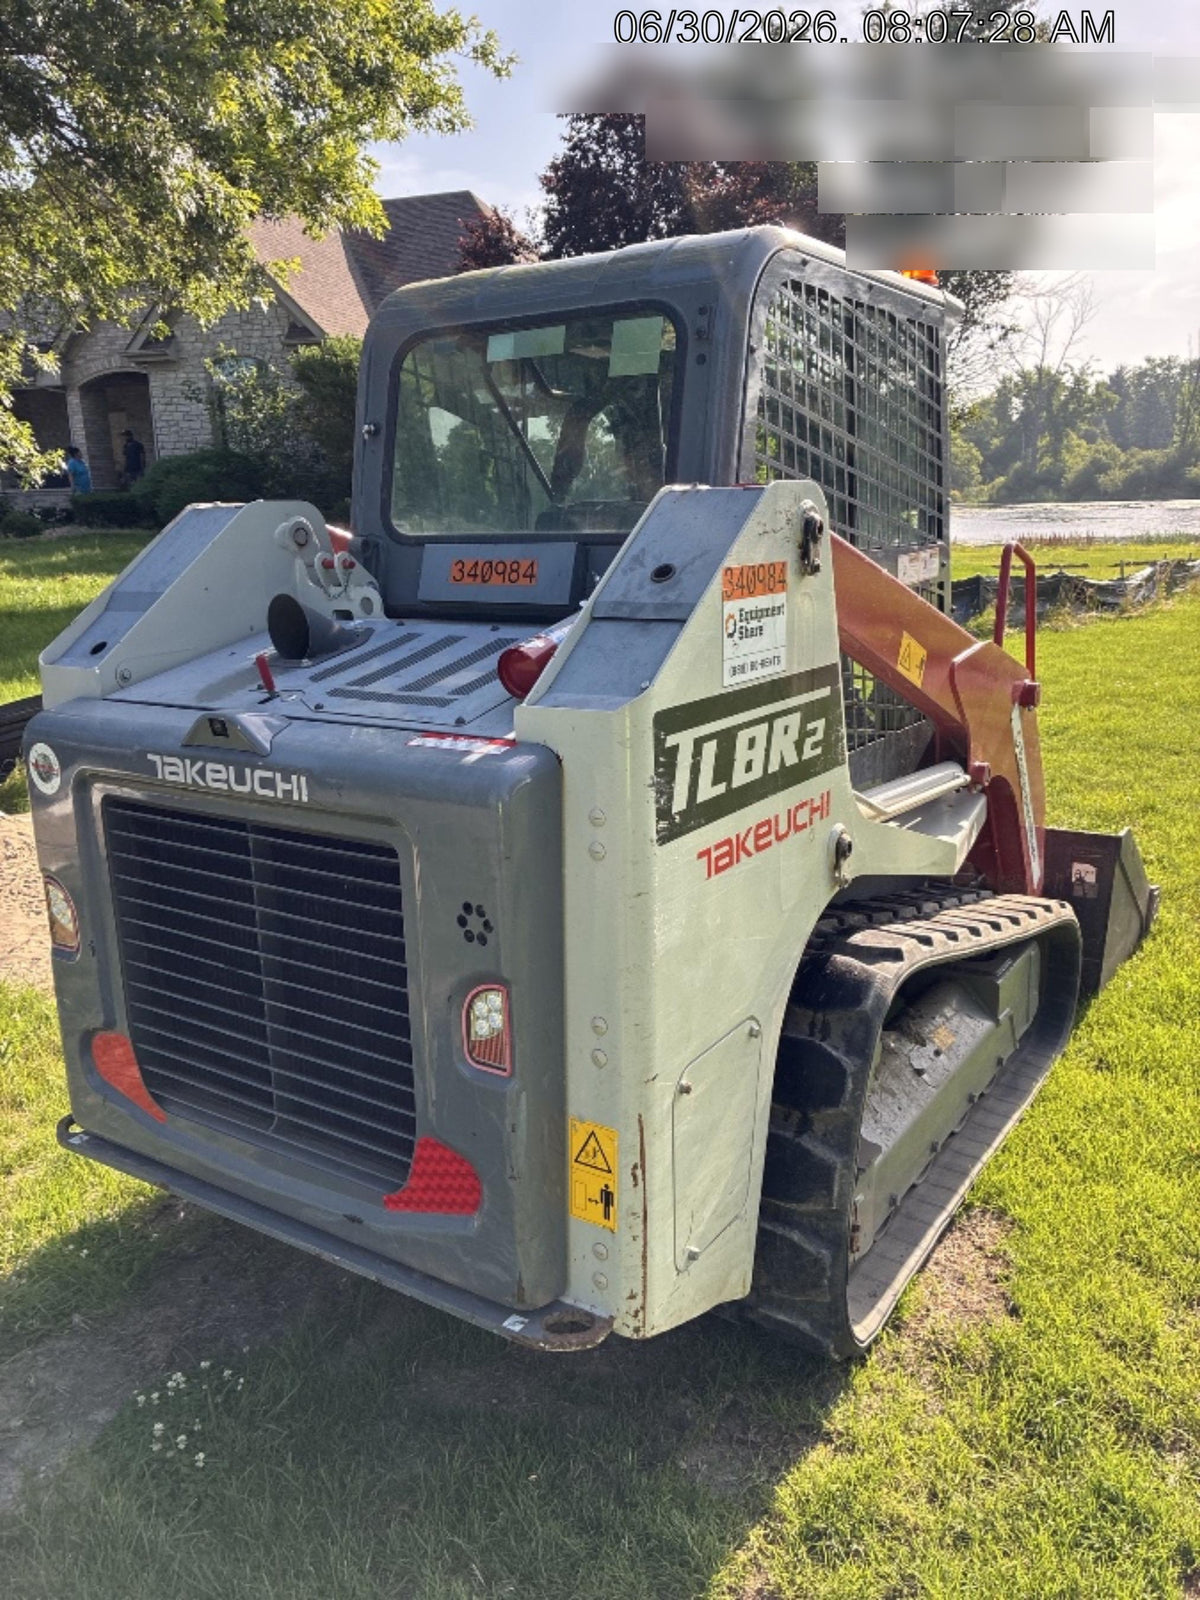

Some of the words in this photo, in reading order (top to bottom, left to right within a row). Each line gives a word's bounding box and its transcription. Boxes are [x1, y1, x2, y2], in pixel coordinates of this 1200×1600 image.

[452, 560, 536, 584] 340984
[724, 561, 786, 598] 340984
[738, 603, 785, 625] Equipment
[738, 625, 764, 640] Share
